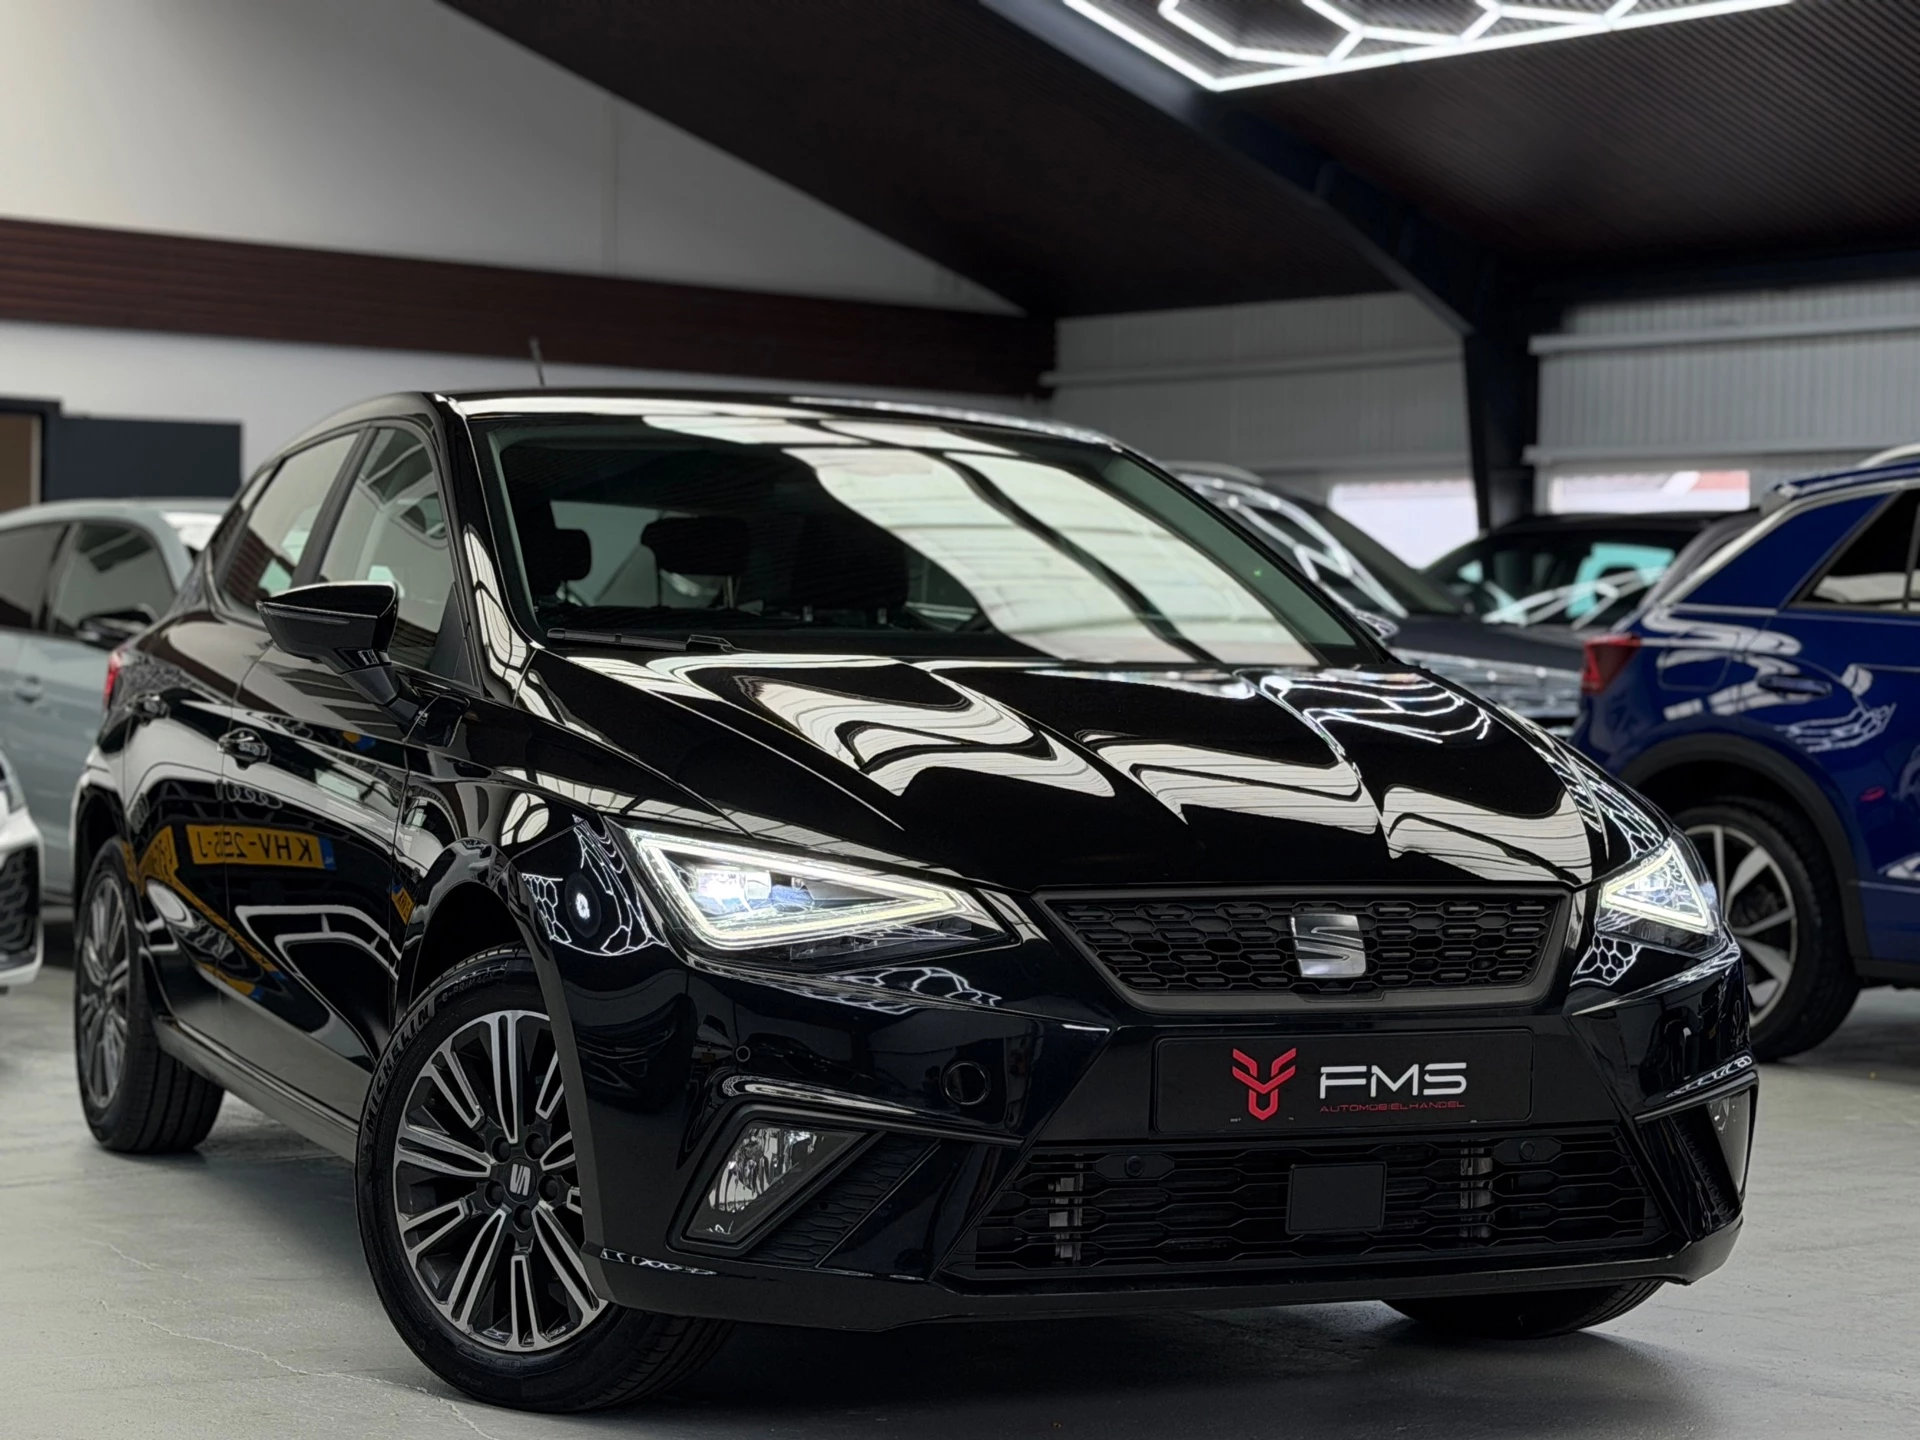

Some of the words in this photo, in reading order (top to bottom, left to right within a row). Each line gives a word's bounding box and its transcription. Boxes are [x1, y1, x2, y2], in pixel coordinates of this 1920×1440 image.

[365, 1003, 432, 1134] MICHELIN
[1319, 1062, 1467, 1099] FMS
[1319, 1100, 1466, 1113] AUTOMOBIELHANDEL
